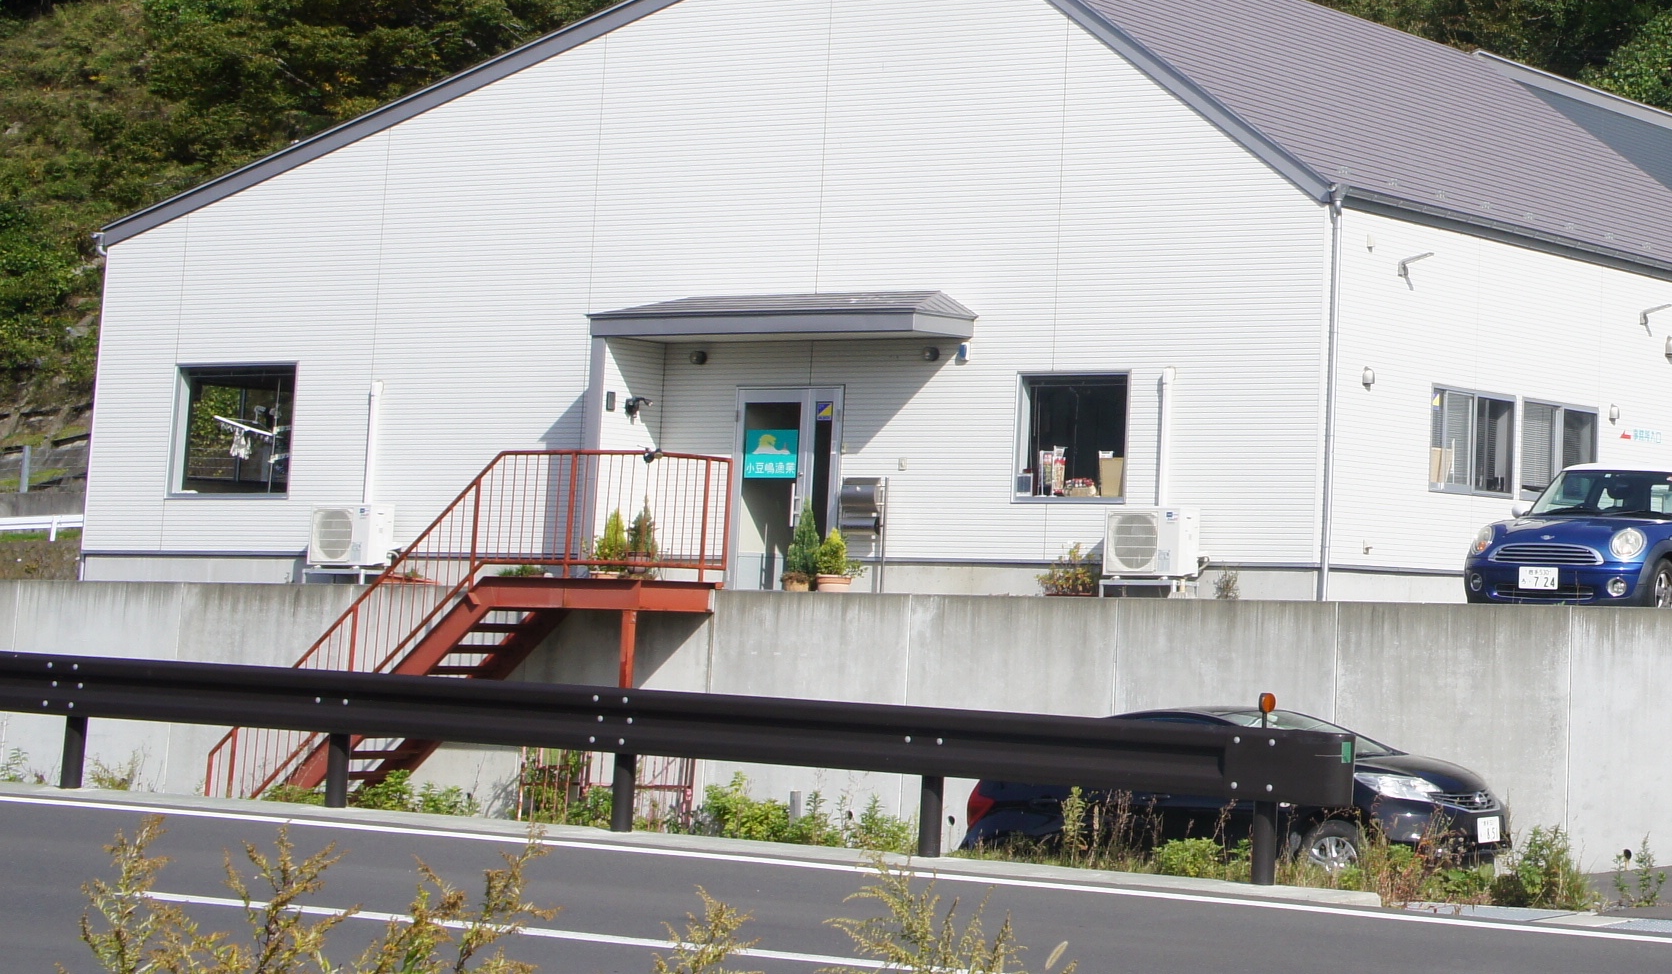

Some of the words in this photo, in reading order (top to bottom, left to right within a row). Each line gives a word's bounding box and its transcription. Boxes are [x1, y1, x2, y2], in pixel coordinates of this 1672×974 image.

[746, 462, 796, 474] 小豆嶋漁業
